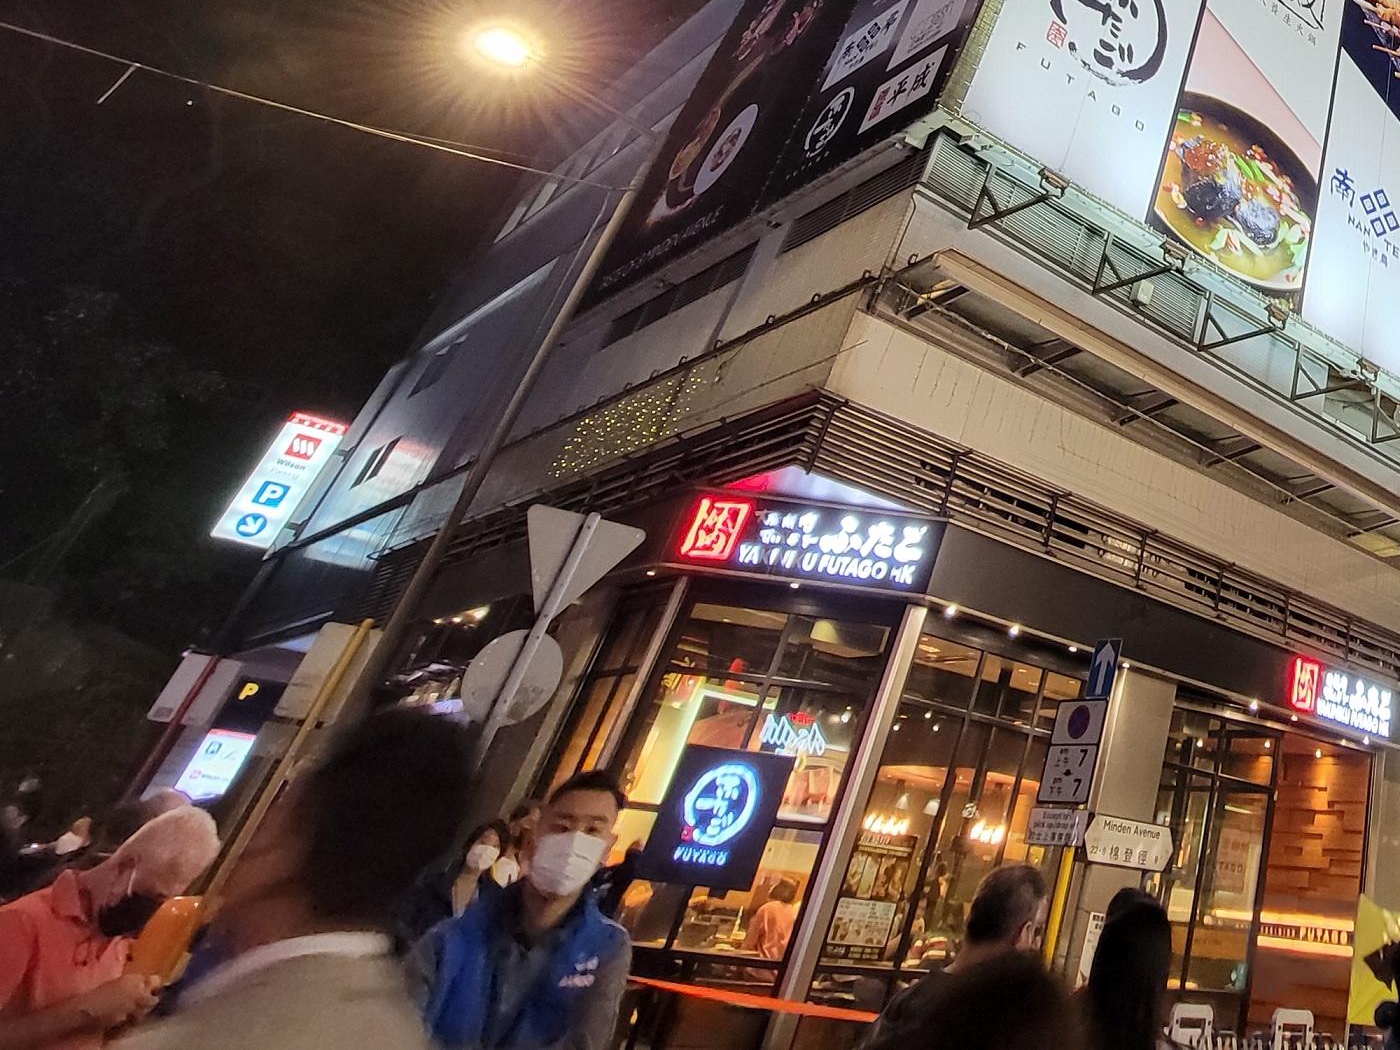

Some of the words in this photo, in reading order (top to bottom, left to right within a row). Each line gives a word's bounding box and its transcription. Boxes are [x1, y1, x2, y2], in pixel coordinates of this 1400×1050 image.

[1016, 41, 1145, 131] FUTAGO
[1347, 214, 1371, 236] NAN
[276, 459, 307, 471] Wilson
[820, 553, 888, 581] FUTAGO
[238, 683, 259, 700] P
[1079, 749, 1089, 766] 7
[1072, 779, 1082, 796] 7
[1103, 819, 1131, 835] Minden
[1133, 826, 1161, 840] Avenue
